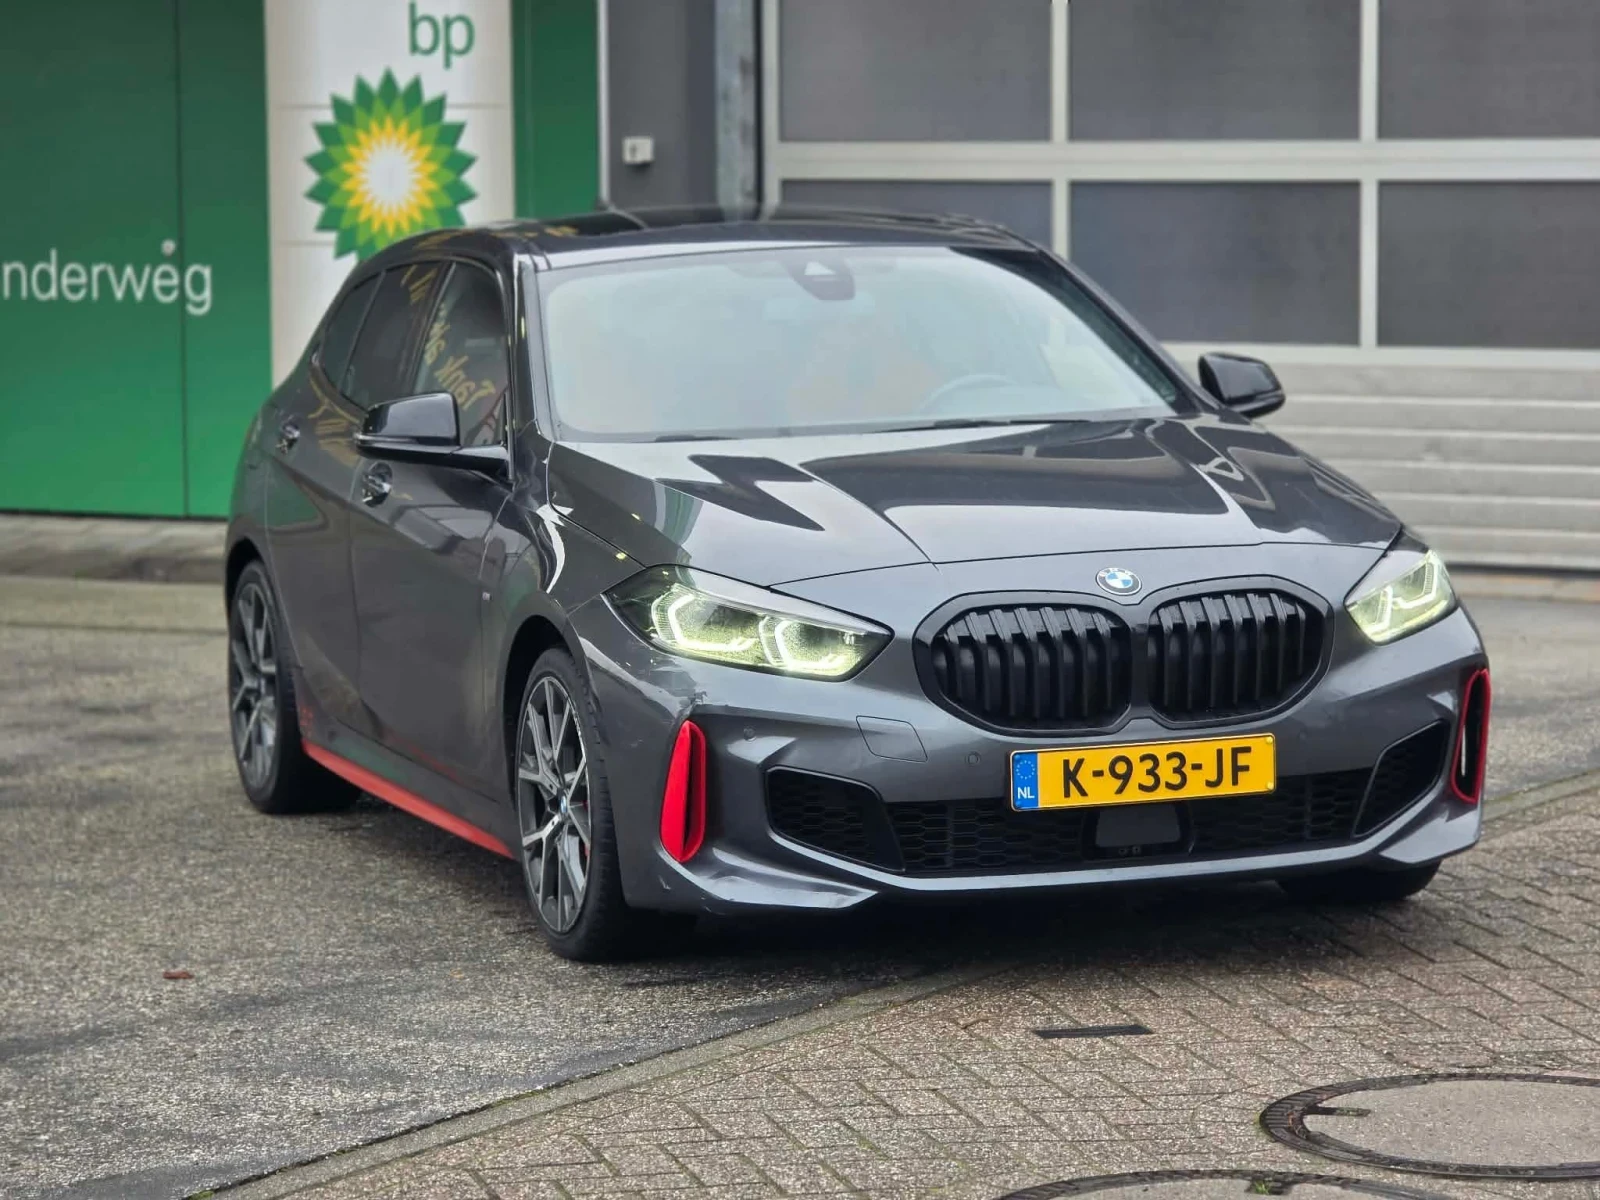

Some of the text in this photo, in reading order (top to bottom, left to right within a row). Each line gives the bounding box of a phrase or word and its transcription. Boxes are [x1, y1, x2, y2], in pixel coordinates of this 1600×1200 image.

[409, 2, 475, 70] bp
[1017, 787, 1035, 799] NL
[1062, 746, 1252, 798] K-933-JF
